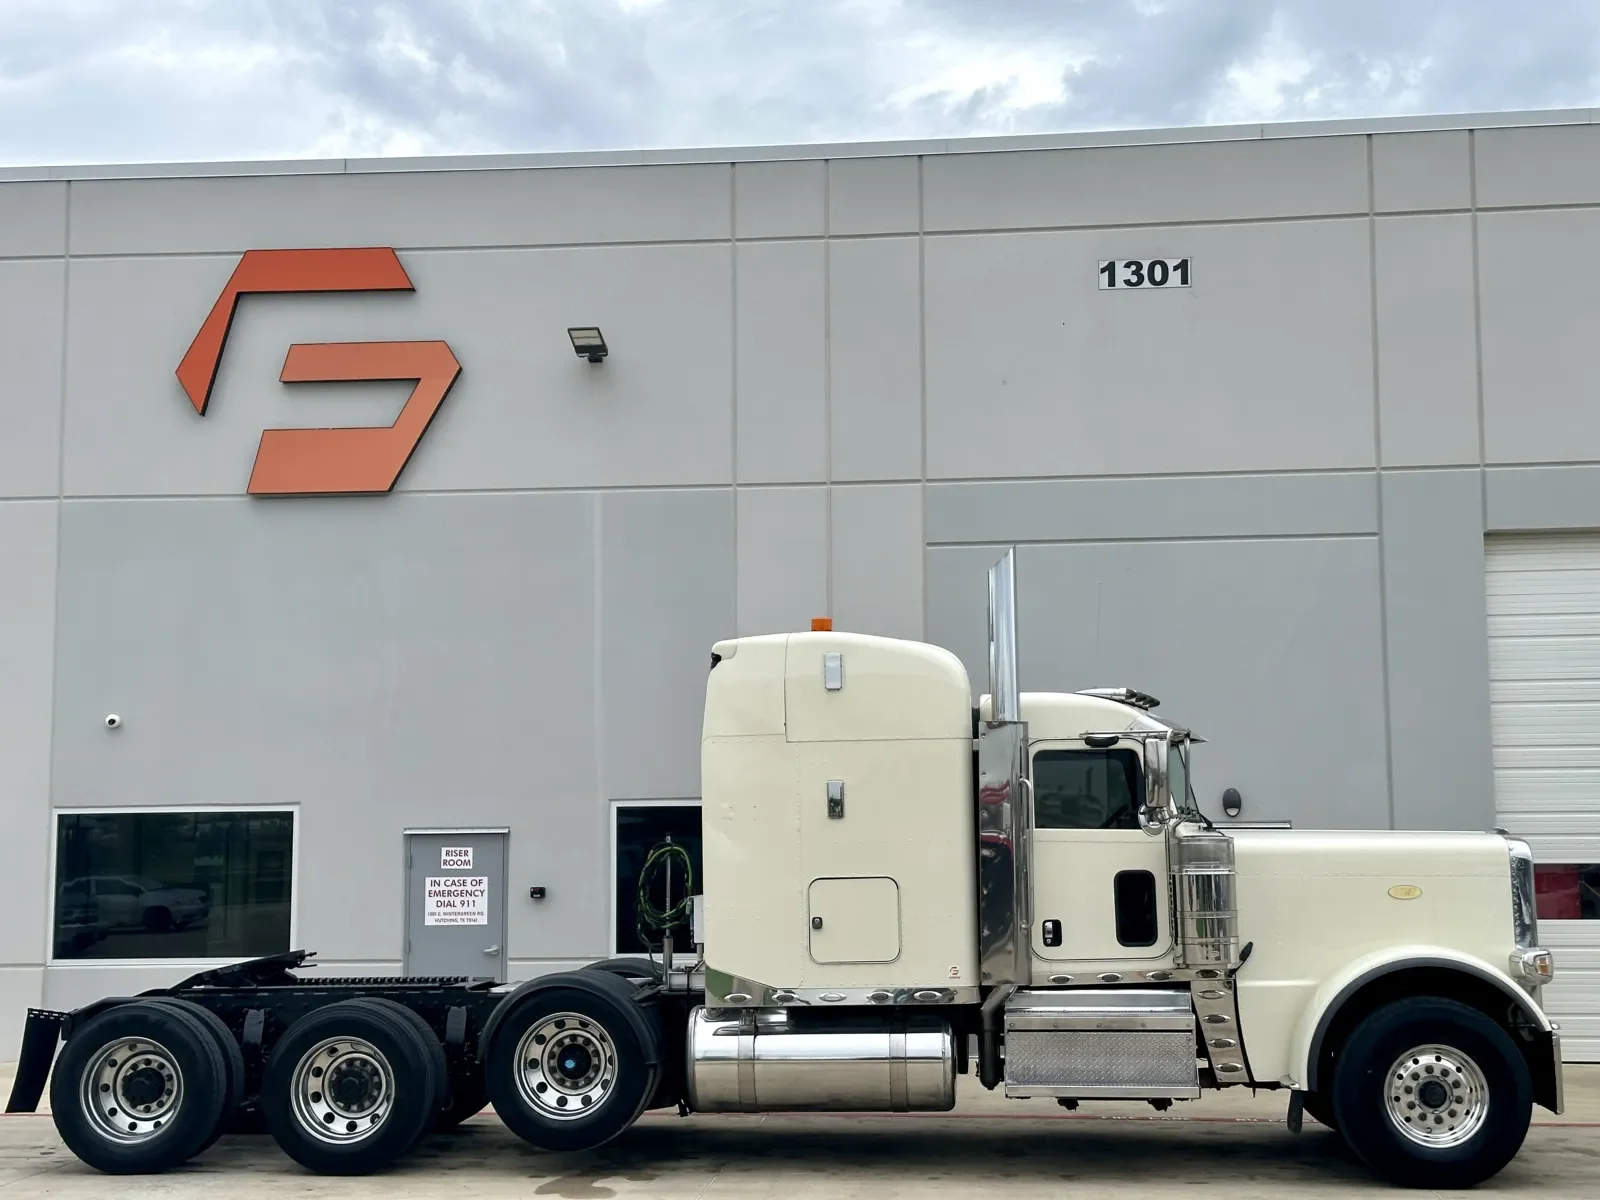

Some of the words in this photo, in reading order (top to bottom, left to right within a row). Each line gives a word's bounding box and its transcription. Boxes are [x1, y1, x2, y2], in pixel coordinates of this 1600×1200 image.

[1100, 259, 1189, 287] 1301
[445, 849, 469, 857] RISER
[443, 859, 471, 867] ROOM
[430, 879, 441, 887] IN
[444, 879, 467, 887] CASE
[470, 879, 483, 887] OF
[428, 889, 485, 898] EMERGENCY
[436, 900, 457, 908] DIAL
[460, 900, 476, 908] 911
